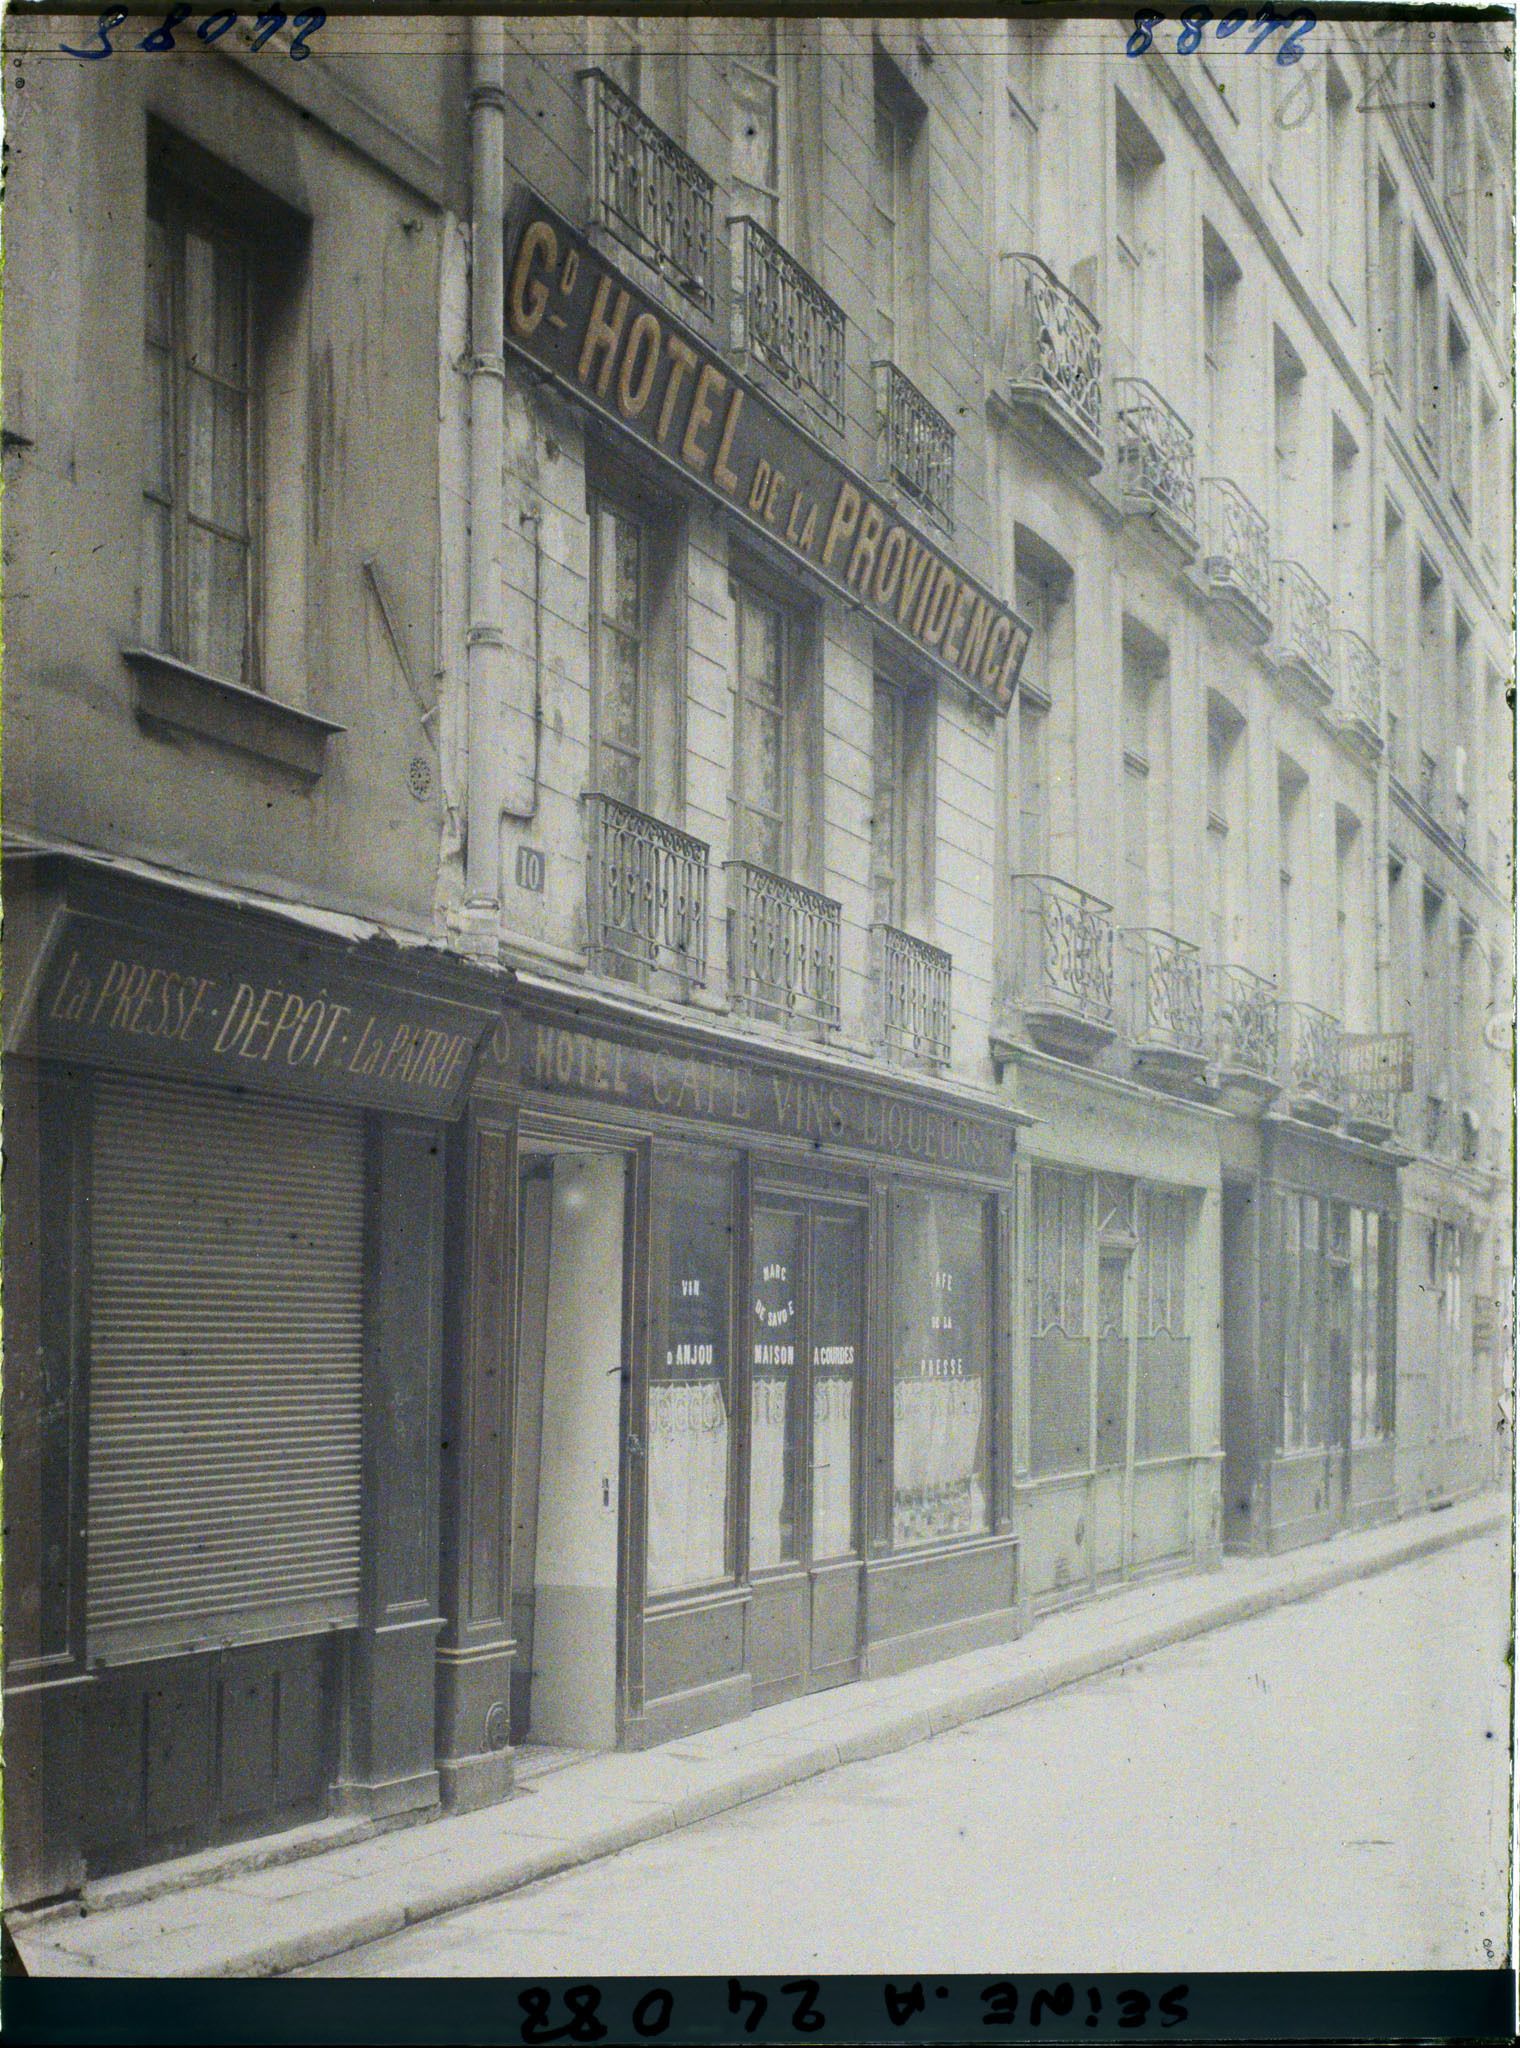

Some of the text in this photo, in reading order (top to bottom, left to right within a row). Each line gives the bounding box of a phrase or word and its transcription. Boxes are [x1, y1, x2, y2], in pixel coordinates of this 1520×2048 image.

[578, 277, 744, 494] HOTEL
[748, 458, 785, 522] DE
[785, 489, 817, 551] LA
[822, 480, 1030, 702] PROVIDENCE
[520, 849, 540, 891] 10
[51, 950, 91, 1020] La
[91, 959, 216, 1042] PRESSE
[350, 1016, 384, 1077] La
[378, 1022, 473, 1090] PATRIE
[772, 1073, 845, 1137] VINS
[863, 1095, 985, 1168] LIQUEURS
[762, 1263, 787, 1282] MARC
[681, 1279, 700, 1297] VIN
[754, 1299, 795, 1328] DE SAVOE
[675, 1343, 713, 1366] ANJOU
[753, 1344, 795, 1366] MAISON
[920, 1358, 963, 1377] PRESSE
